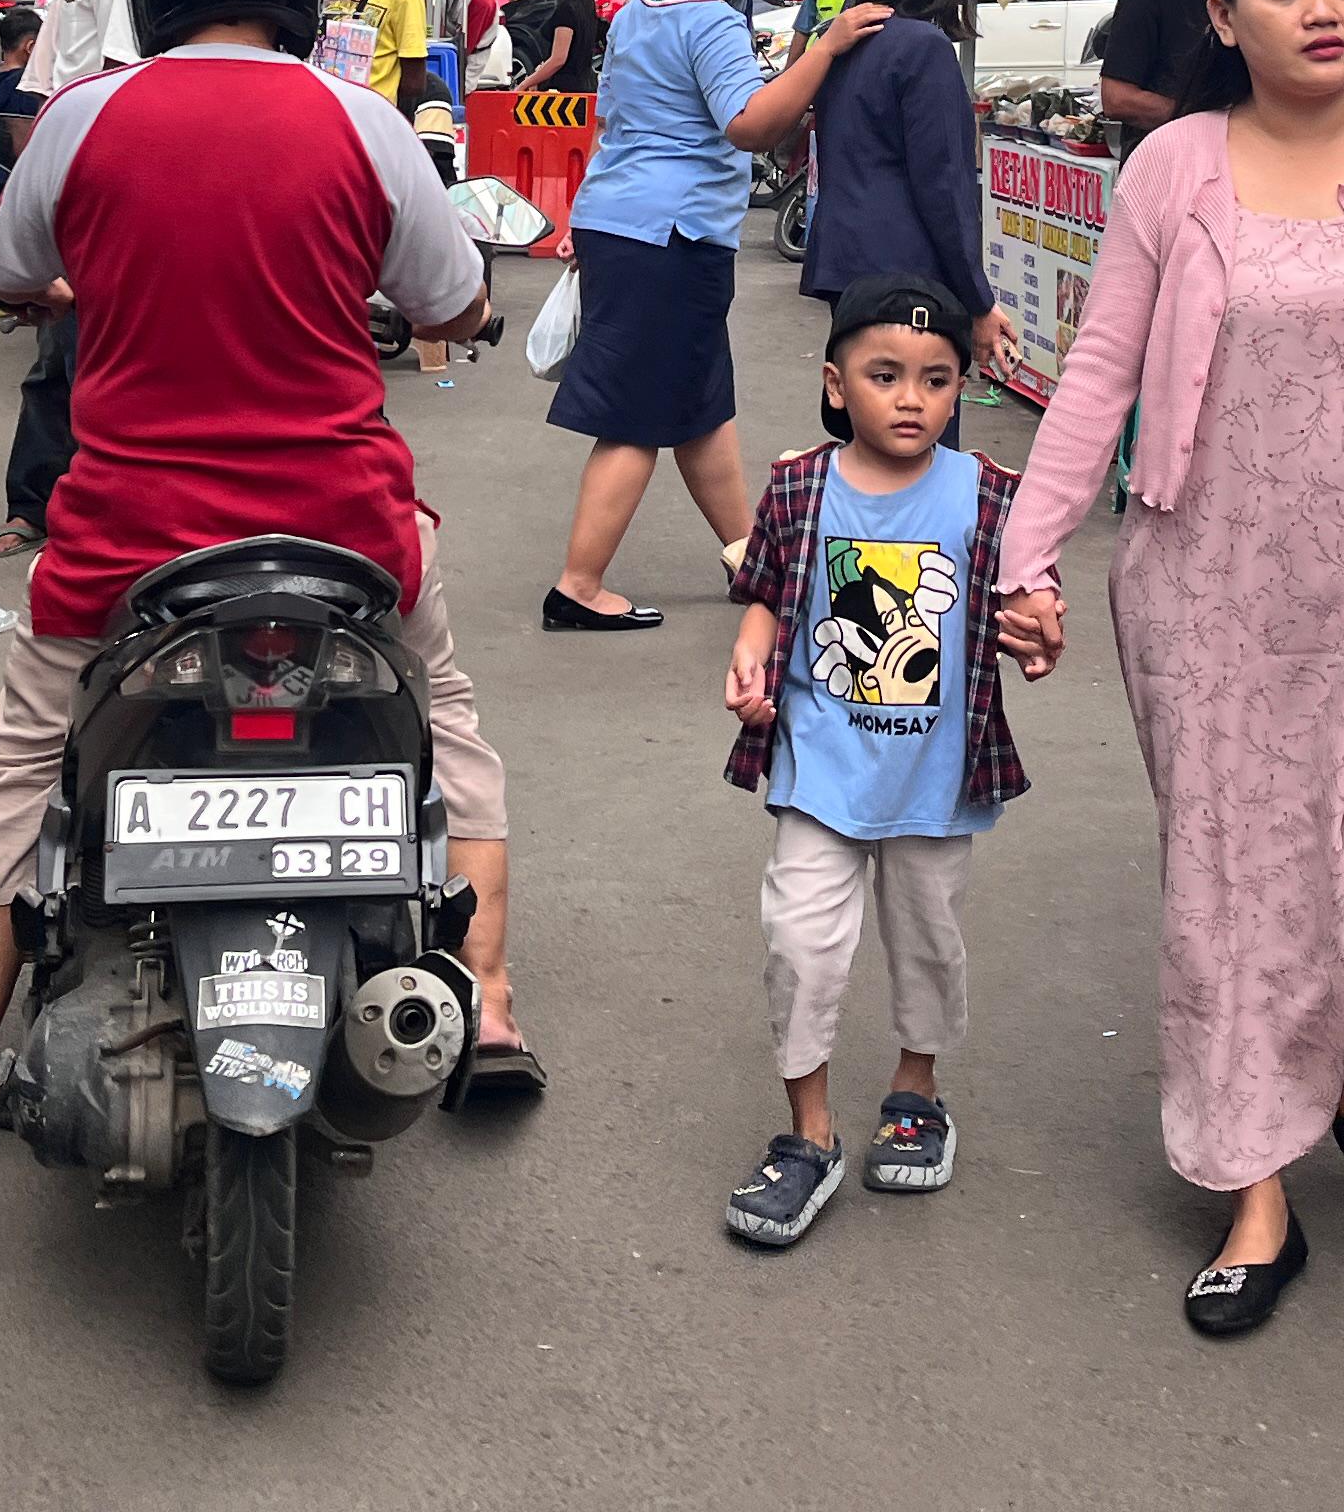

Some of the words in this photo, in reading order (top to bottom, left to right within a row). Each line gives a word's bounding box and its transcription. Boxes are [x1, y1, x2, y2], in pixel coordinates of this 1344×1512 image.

[990, 147, 1040, 208] KETAN
[848, 711, 939, 736] MOMSAY
[127, 791, 151, 833] A
[188, 787, 297, 831] 2227
[340, 786, 390, 827] CH
[152, 846, 233, 870] ATM
[271, 849, 316, 874] 03
[341, 848, 389, 873] 29
[214, 979, 280, 1003] THIS
[282, 980, 309, 1002] IS
[203, 1001, 320, 1021] WORLDWIDE
